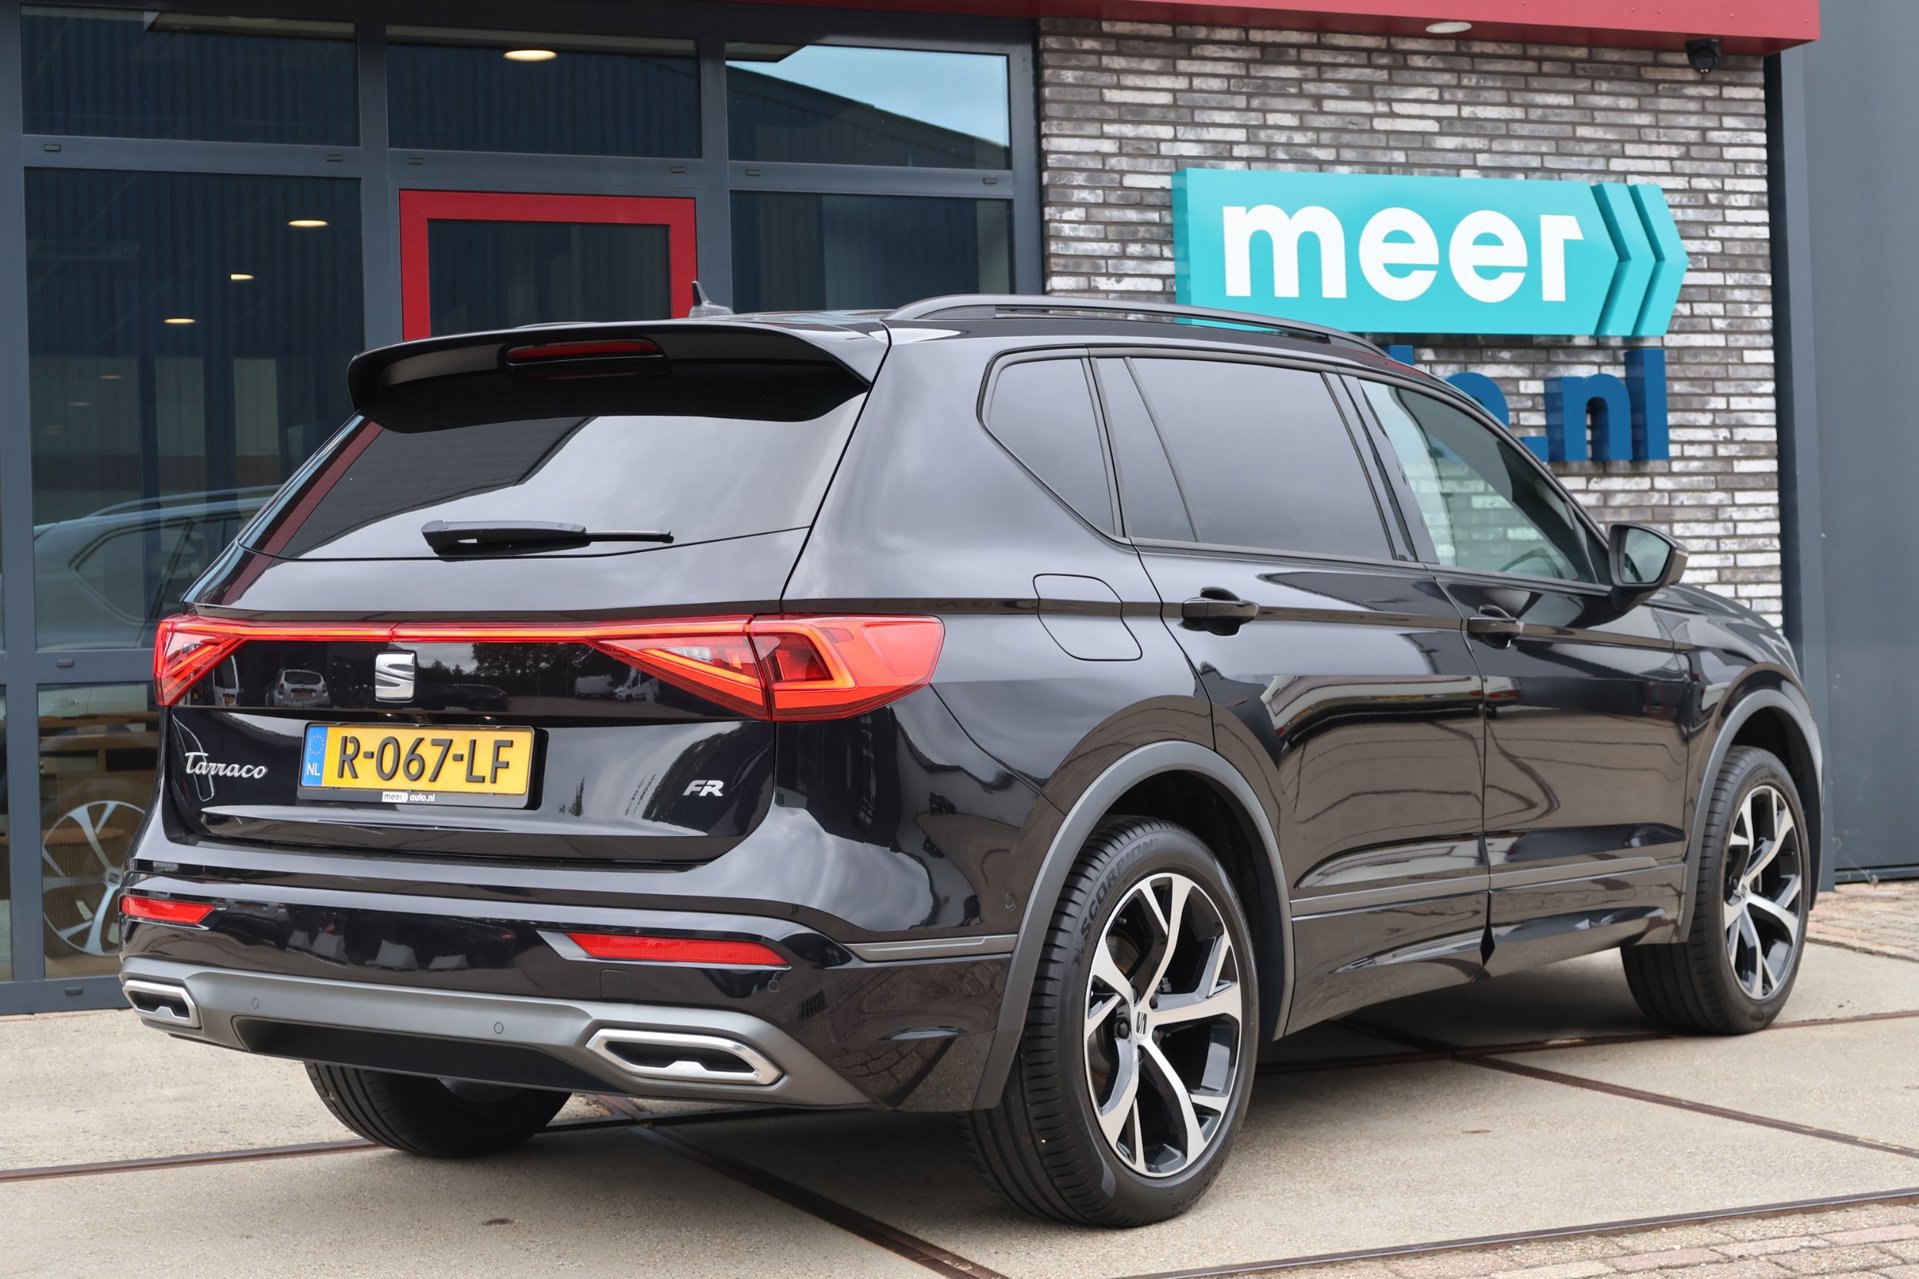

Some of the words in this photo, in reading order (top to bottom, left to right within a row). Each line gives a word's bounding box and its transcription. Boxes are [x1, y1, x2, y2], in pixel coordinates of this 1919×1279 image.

[1222, 204, 1584, 303] meer
[185, 752, 268, 779] Tarraco
[306, 762, 320, 777] NL
[337, 735, 514, 784] R-067-LF
[384, 792, 404, 801] meer
[409, 793, 436, 802] auto.nl
[683, 780, 724, 797] FR
[1080, 838, 1155, 941] SCORPION
